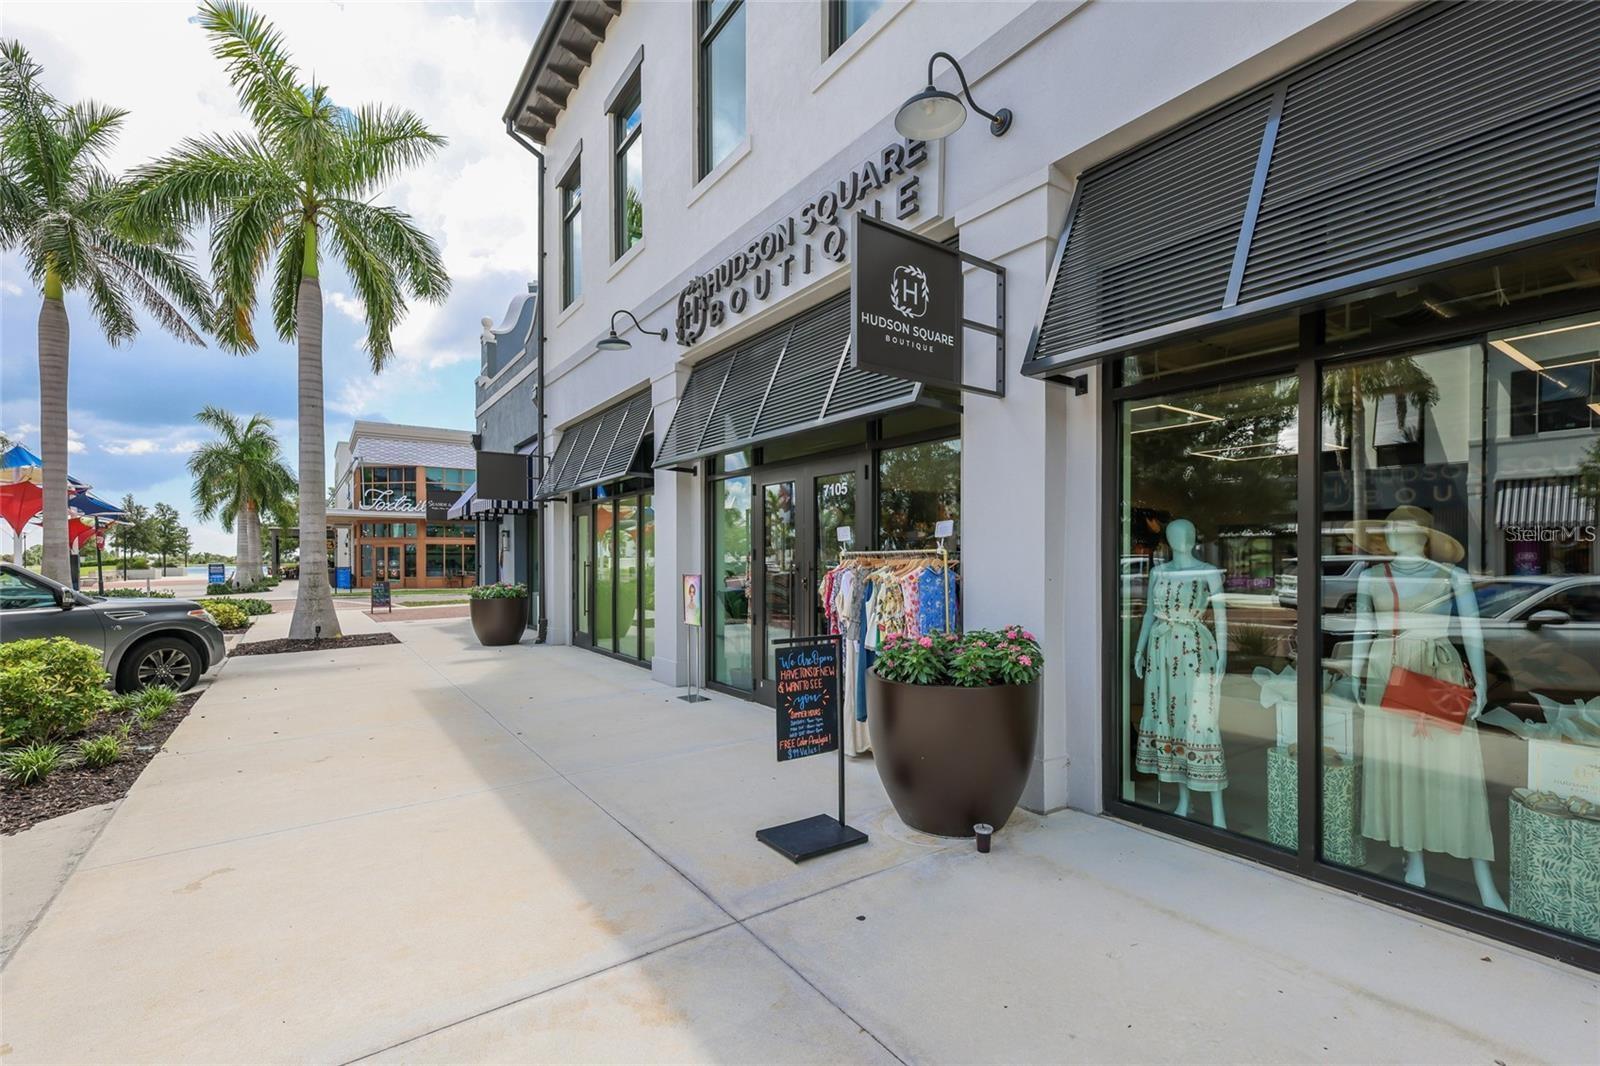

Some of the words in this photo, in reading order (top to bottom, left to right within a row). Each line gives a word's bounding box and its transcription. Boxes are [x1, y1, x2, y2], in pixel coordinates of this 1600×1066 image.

[705, 216, 795, 298] HUDSON
[801, 138, 928, 236] SQUARE
[903, 279, 918, 305] H
[861, 311, 910, 335] HUDSON
[912, 325, 954, 347] SQUARE
[885, 334, 934, 353] BOUTIQUE
[823, 482, 848, 497] 7105
[359, 488, 428, 512] Foxtail
[779, 652, 796, 669] We
[797, 652, 812, 666] Are
[811, 650, 833, 668] Open
[780, 668, 800, 680] HAVE
[820, 665, 835, 677] NEW
[810, 678, 823, 689] SEE
[793, 694, 821, 710] you
[779, 739, 796, 750] FREE
